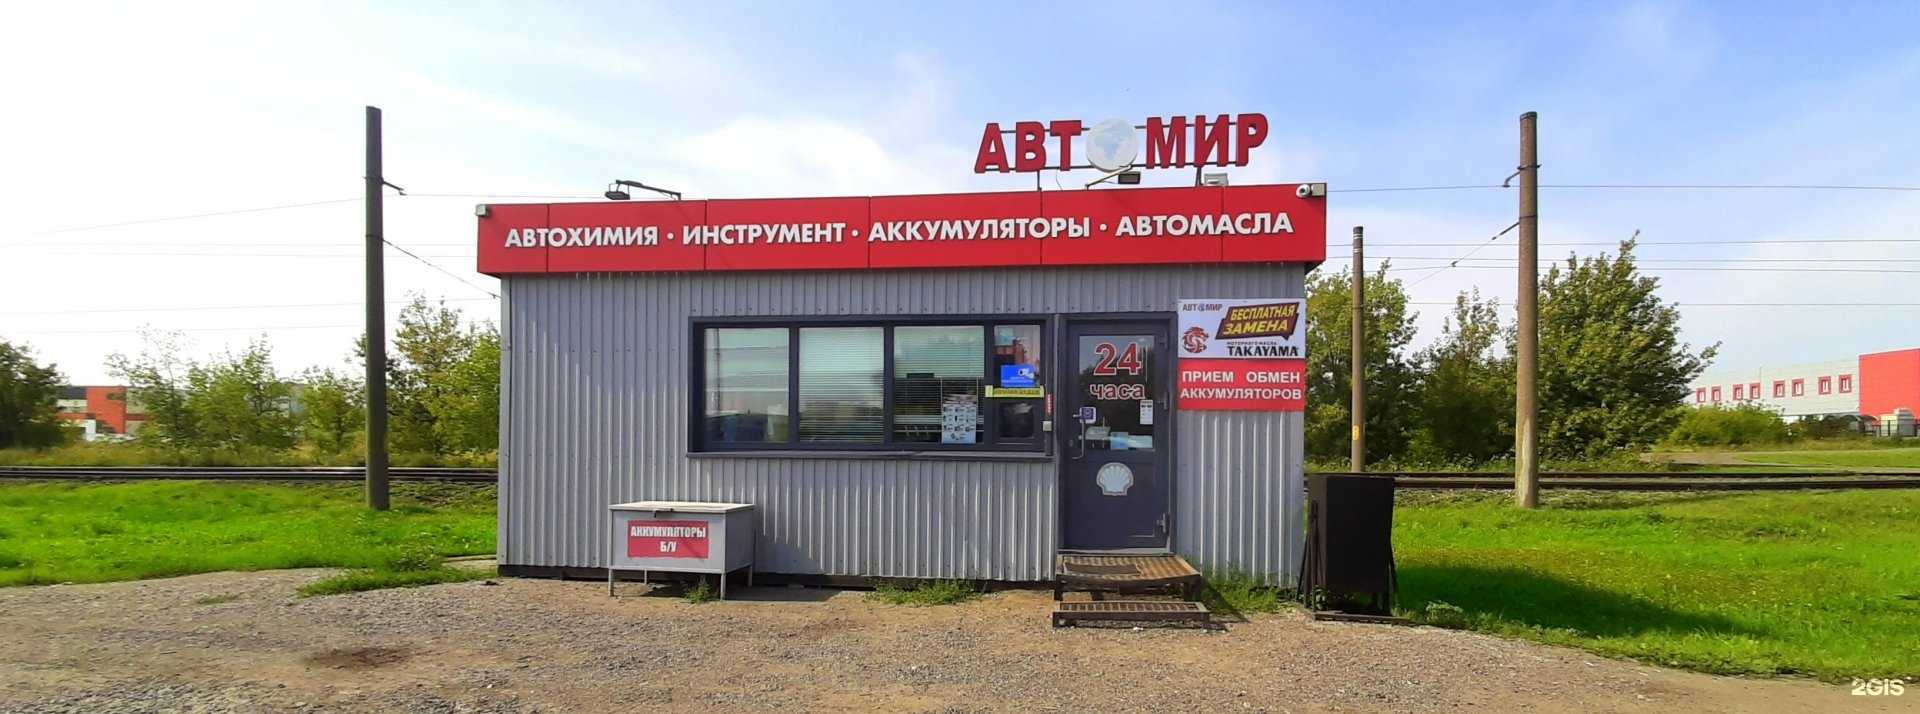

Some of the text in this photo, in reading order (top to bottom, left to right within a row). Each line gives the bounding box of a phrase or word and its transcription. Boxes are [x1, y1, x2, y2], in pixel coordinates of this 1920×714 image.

[505, 212, 1294, 248] АВТОХИМИЯ ИНСТРУМЕНТ АККУМУЛЯТОРЫ АВТОМАСЛА
[1231, 305, 1295, 320] БЕСПЛАТНАЯ
[1222, 320, 1288, 334] ЗАМЕНА
[1227, 345, 1298, 356] TAKAYAMA
[1093, 342, 1142, 375] 24
[1182, 371, 1300, 383] ПРИЕМ ОБМЕН
[1089, 384, 1145, 399] часа
[1180, 388, 1301, 399] АККУМУЛЯТОРОВ
[631, 526, 706, 538] АККУМУЛЯТОРЫ
[660, 541, 677, 552] Б/У
